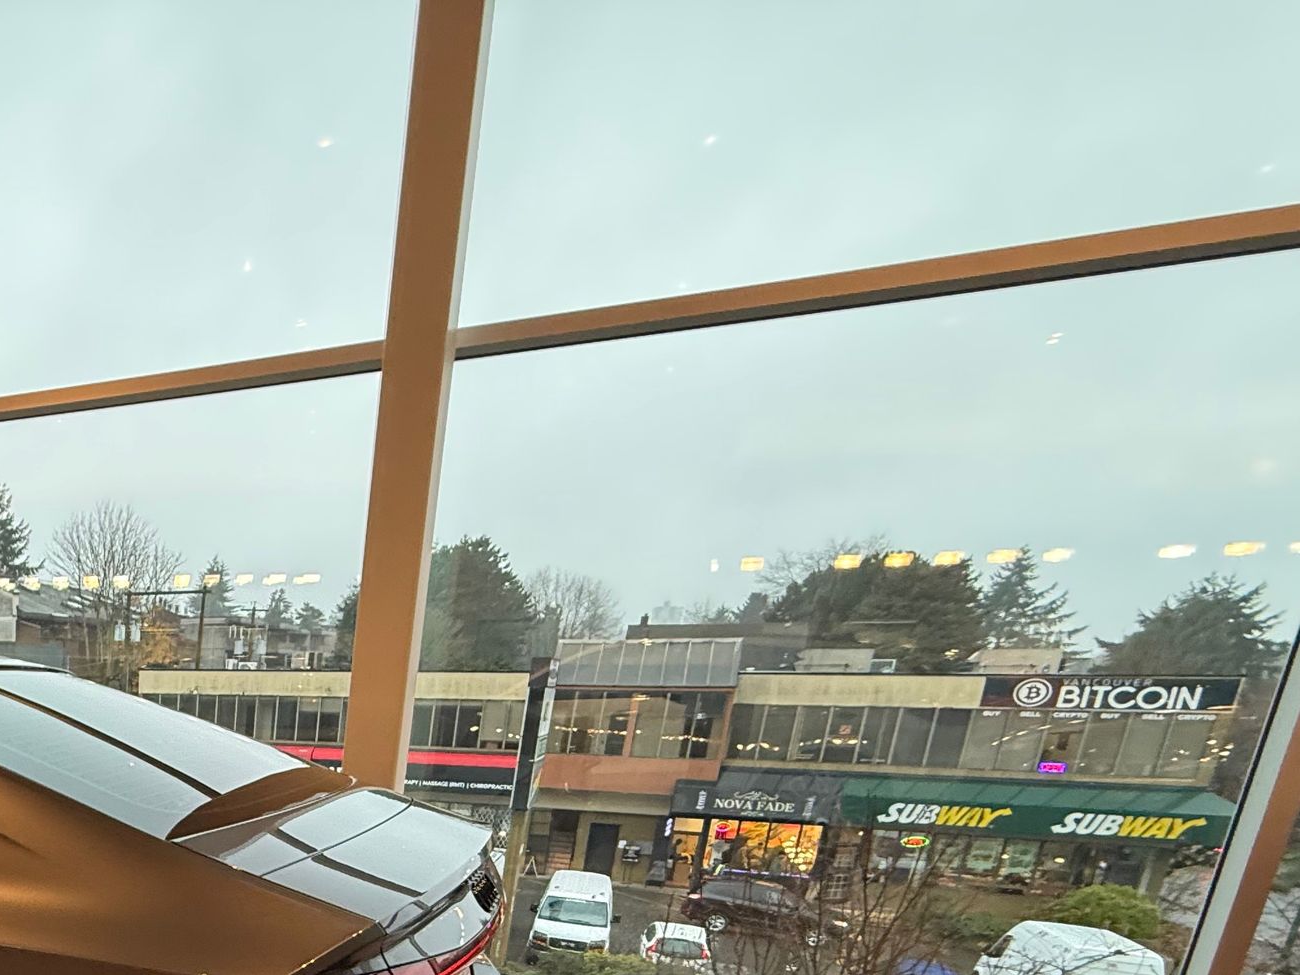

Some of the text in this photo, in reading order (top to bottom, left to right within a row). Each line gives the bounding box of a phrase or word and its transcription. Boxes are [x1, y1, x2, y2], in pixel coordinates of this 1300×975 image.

[1062, 678, 1153, 686] VANCOUVER
[1055, 685, 1203, 709] BITCOIN
[1053, 711, 1089, 719] CRYPTO
[422, 780, 449, 788] MASSAGE
[449, 781, 465, 789] (RMT)
[713, 798, 795, 813] NOVA FADE
[876, 802, 1013, 828] SUBWAY
[1051, 812, 1208, 840] SUBWAY
